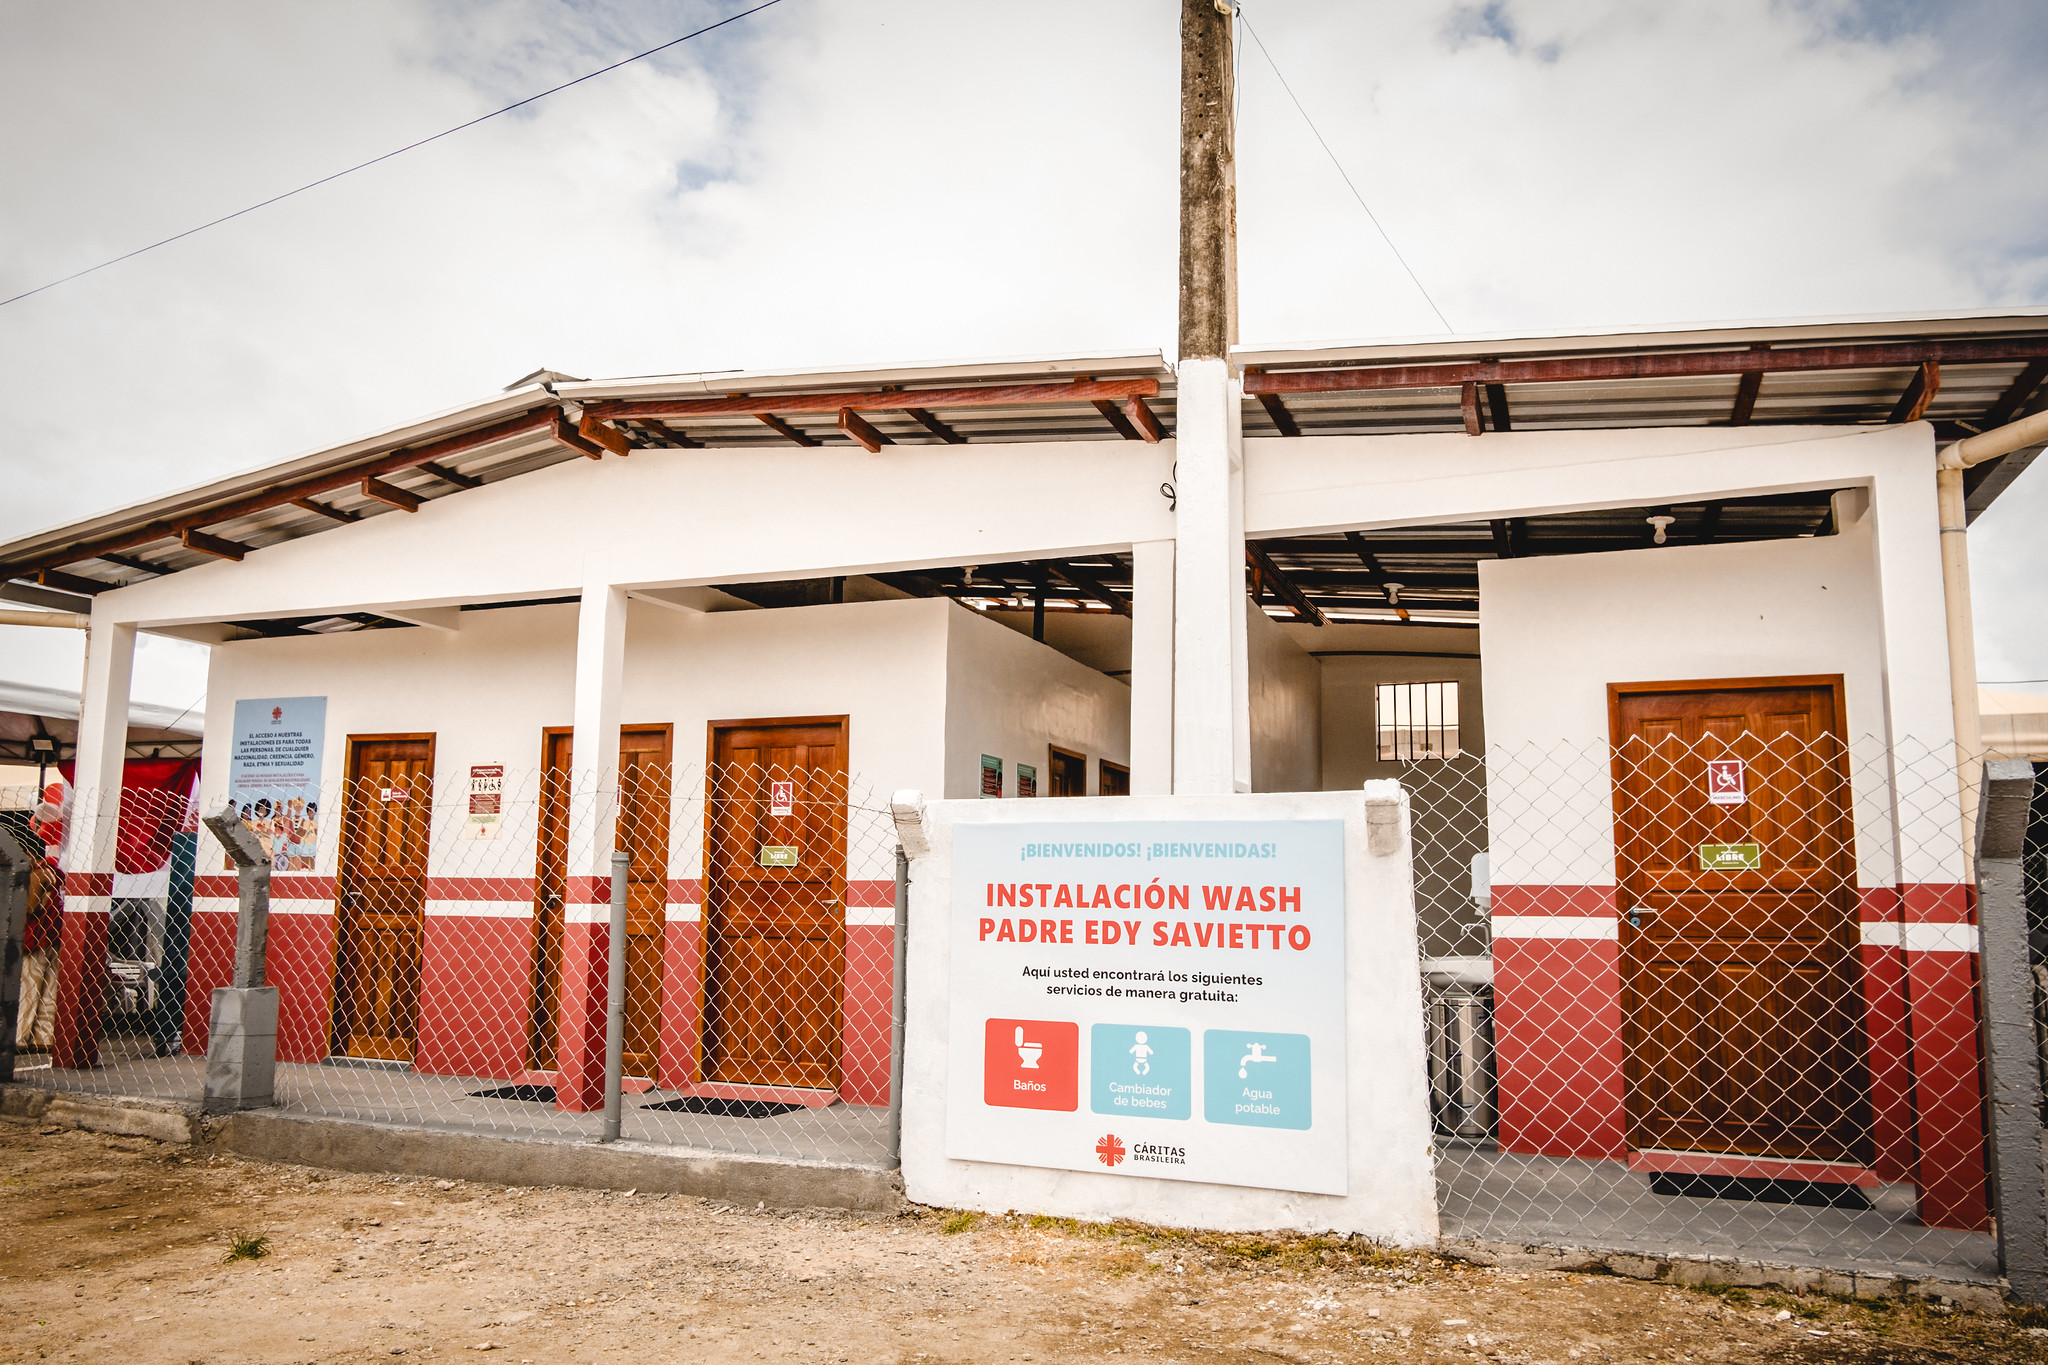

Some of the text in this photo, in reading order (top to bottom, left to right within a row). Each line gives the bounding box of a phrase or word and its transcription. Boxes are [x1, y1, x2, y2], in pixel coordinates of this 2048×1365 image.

[1022, 843, 1275, 860] ¡BIENVENIDOS! ¡BIENVENIDAS!
[1716, 853, 1744, 861] LIBRE
[987, 878, 1300, 912] INSTALACIÓN WASH
[980, 918, 1312, 950] PADRE EDY SAVIETTO
[1023, 966, 1262, 986] Aquí usted encontrará los siguientes
[1047, 985, 1237, 1002] servicios de manera gratuita:
[1013, 1079, 1046, 1092] Baños
[1109, 1082, 1172, 1096] Cambiador
[1242, 1087, 1272, 1101] Agua
[1114, 1095, 1167, 1109] de bebes
[1235, 1100, 1280, 1115] potable
[1134, 1142, 1185, 1157] CÁRITAS
[1134, 1154, 1185, 1164] BRASILEIRA
